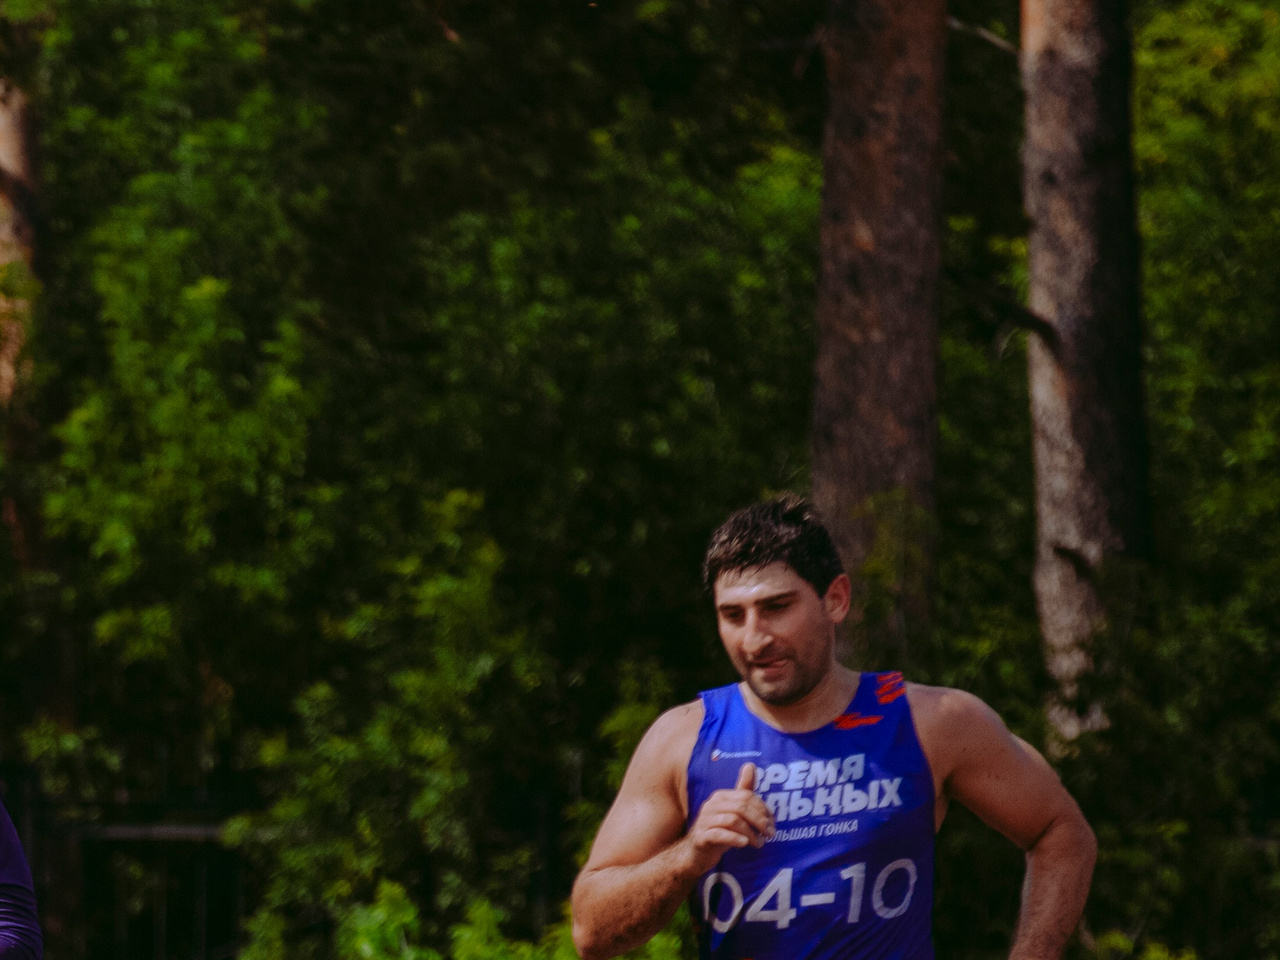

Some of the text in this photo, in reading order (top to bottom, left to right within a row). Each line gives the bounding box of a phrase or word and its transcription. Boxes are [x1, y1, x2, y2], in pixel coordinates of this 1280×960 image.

[762, 777, 904, 823] ЛЬНЫХ
[767, 819, 859, 843] ЛЬШАЯ ГОНКА
[703, 858, 918, 934] 04-10
